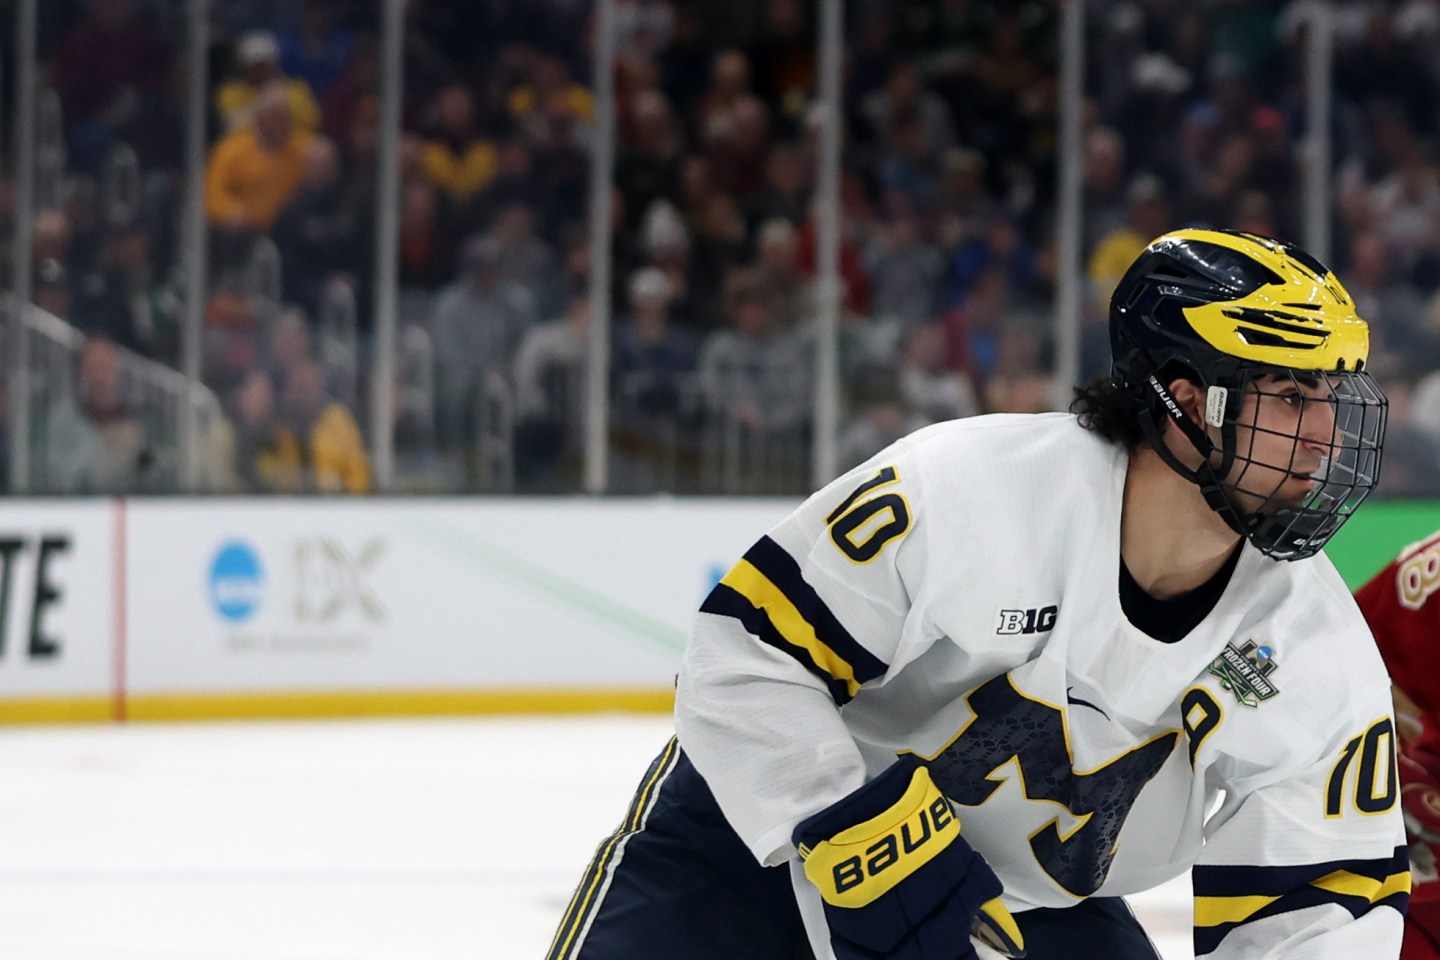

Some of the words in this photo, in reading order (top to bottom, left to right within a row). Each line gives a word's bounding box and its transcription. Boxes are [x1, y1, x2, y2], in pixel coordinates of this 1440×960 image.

[823, 465, 912, 565] 10
[1246, 670, 1272, 696] FOUR
[1323, 714, 1397, 819] 10
